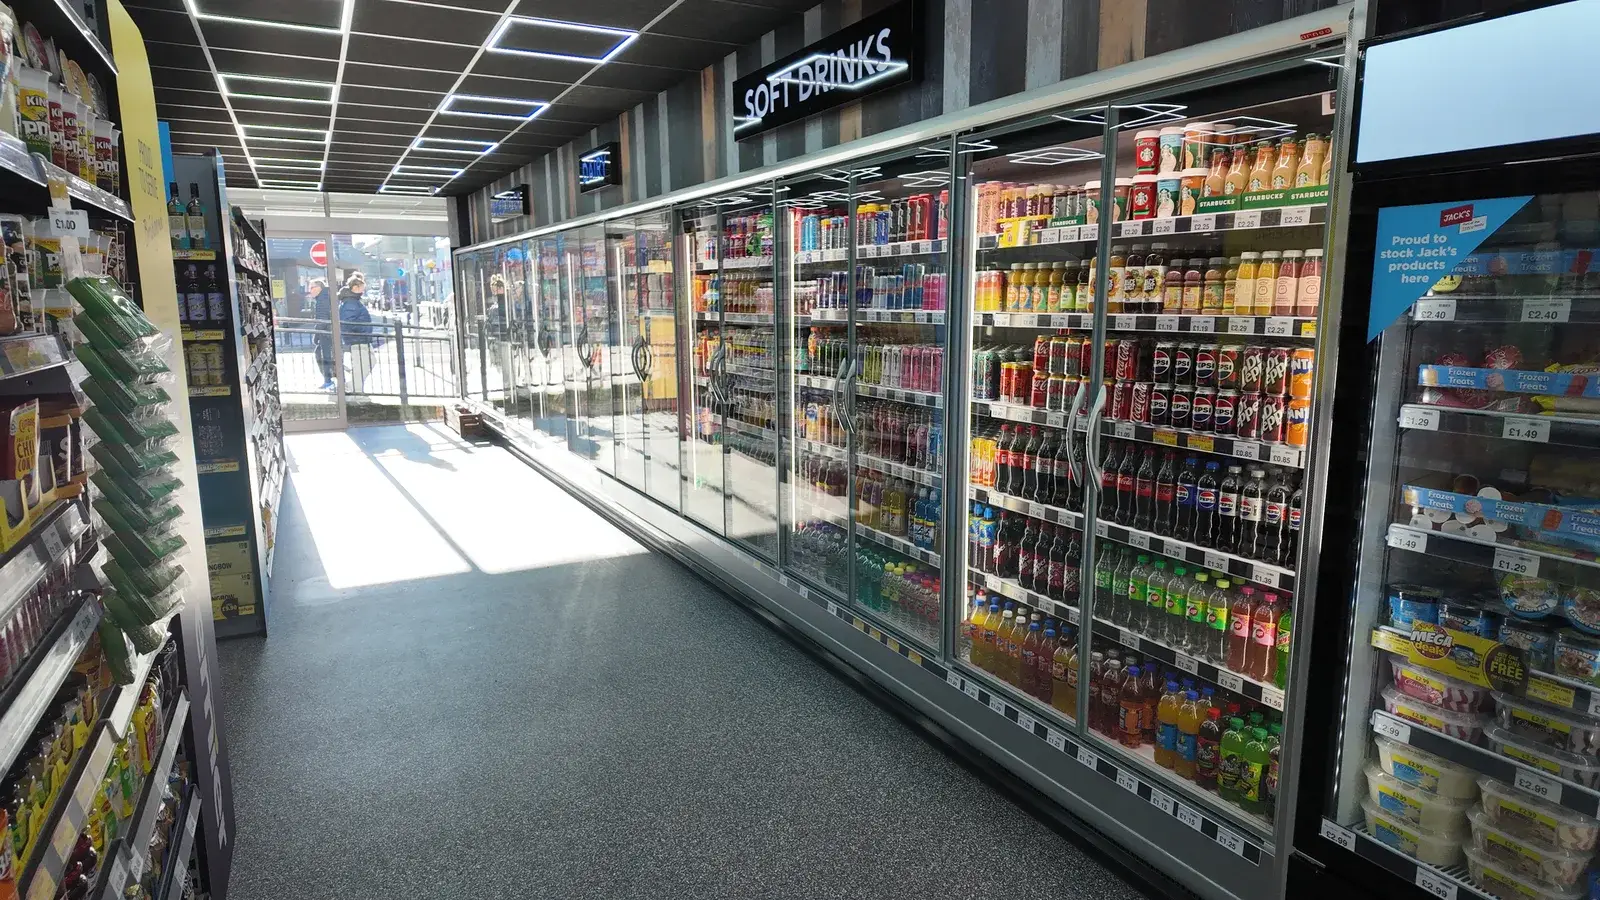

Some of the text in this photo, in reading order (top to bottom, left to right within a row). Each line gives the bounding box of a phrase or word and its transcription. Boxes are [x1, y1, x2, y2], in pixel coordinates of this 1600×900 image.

[744, 27, 892, 120] SOFT DRINKS
[26, 96, 49, 107] KIN
[1245, 192, 1284, 202] STARBUCKS
[1200, 198, 1236, 208] STARBUCKS
[1444, 210, 1470, 222] JACK'S
[56, 218, 76, 230] £1.00
[1194, 222, 1210, 230] £2.25
[1392, 232, 1448, 246] Proud to
[1380, 246, 1457, 259] stock Jack's
[1520, 254, 1552, 262] Frozen
[1388, 260, 1446, 272] products
[1520, 263, 1552, 272] Treats
[1401, 272, 1430, 284] here
[1420, 311, 1446, 320] £2.40
[1528, 310, 1558, 320] £2.40
[1448, 368, 1476, 378] Frozen
[1518, 372, 1550, 382] Frozen
[1448, 377, 1475, 386] Treats
[1518, 382, 1548, 391] Treats
[1405, 416, 1429, 426] £1.29
[1508, 428, 1538, 439] £1.49
[1428, 491, 1456, 501] Frozen
[1428, 499, 1454, 510] Treats
[1495, 502, 1526, 513] Frozen
[1495, 511, 1524, 522] Treats
[1571, 514, 1600, 525] Froze
[1571, 522, 1600, 535] Treat
[1394, 537, 1417, 549] £1.49
[208, 562, 232, 572] NGBOW
[1498, 560, 1527, 573] £1.29
[1255, 576, 1272, 584] £1.39
[1411, 631, 1453, 648] MEGA
[1416, 642, 1445, 656] deals
[1490, 662, 1523, 680] FREE
[1220, 679, 1236, 690] £1.30
[1264, 698, 1282, 708] £1.59
[196, 607, 227, 850] emier
[1378, 723, 1400, 736] 2.99
[1118, 781, 1132, 791] £1.19
[1518, 778, 1548, 796] £2.99
[1152, 798, 1168, 811] £1.15
[1179, 812, 1196, 826] £1.15
[1219, 836, 1236, 851] £1.25
[1326, 830, 1348, 846] £2.99
[1421, 879, 1448, 898] £2.99
